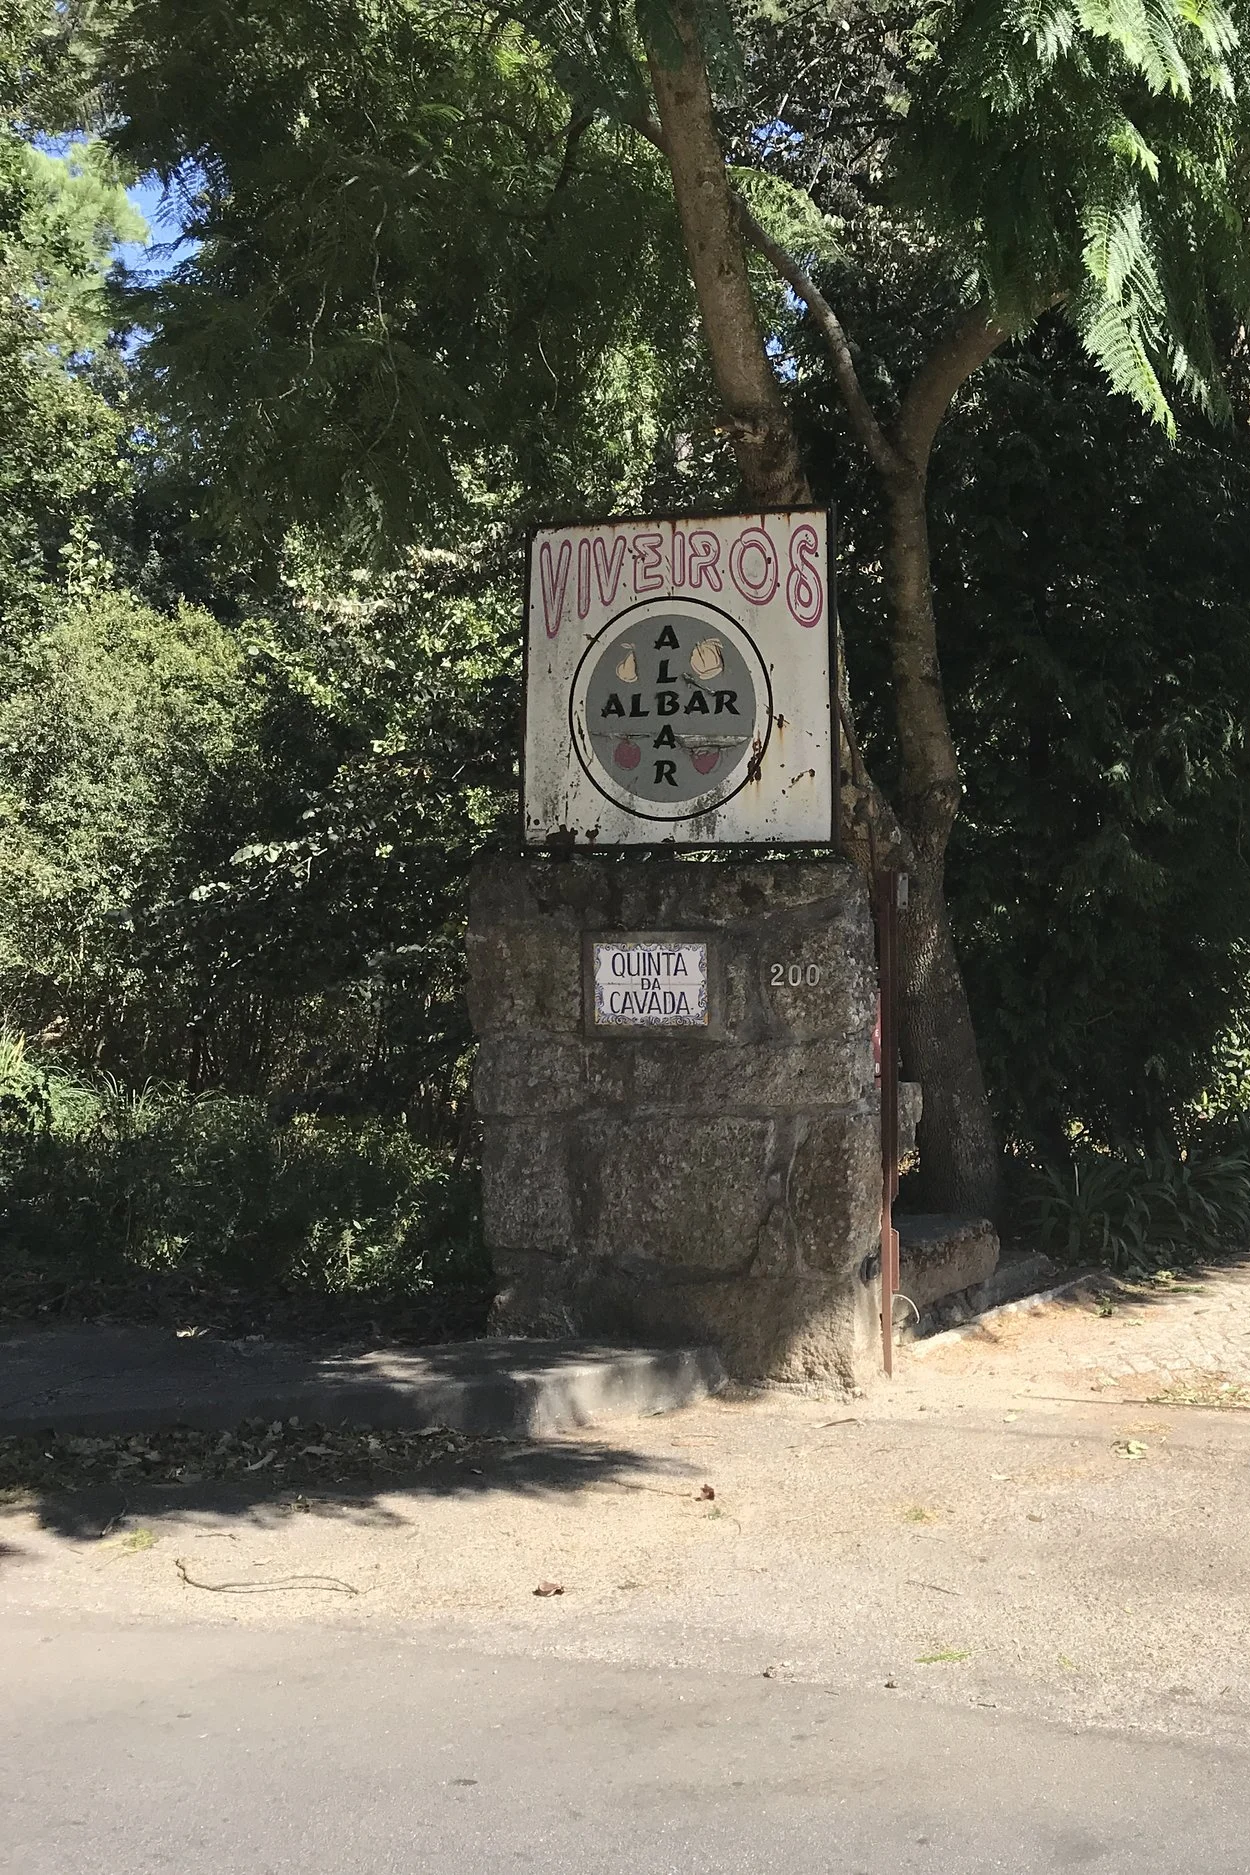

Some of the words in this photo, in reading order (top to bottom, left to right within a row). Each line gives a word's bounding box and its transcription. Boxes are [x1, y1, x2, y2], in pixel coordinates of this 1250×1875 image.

[539, 524, 823, 639] VIVEIROS
[600, 690, 740, 718] ALBAR
[653, 624, 680, 787] ALBAR
[611, 952, 688, 978] QUINTA
[770, 963, 820, 987] 200
[640, 977, 661, 991] DA
